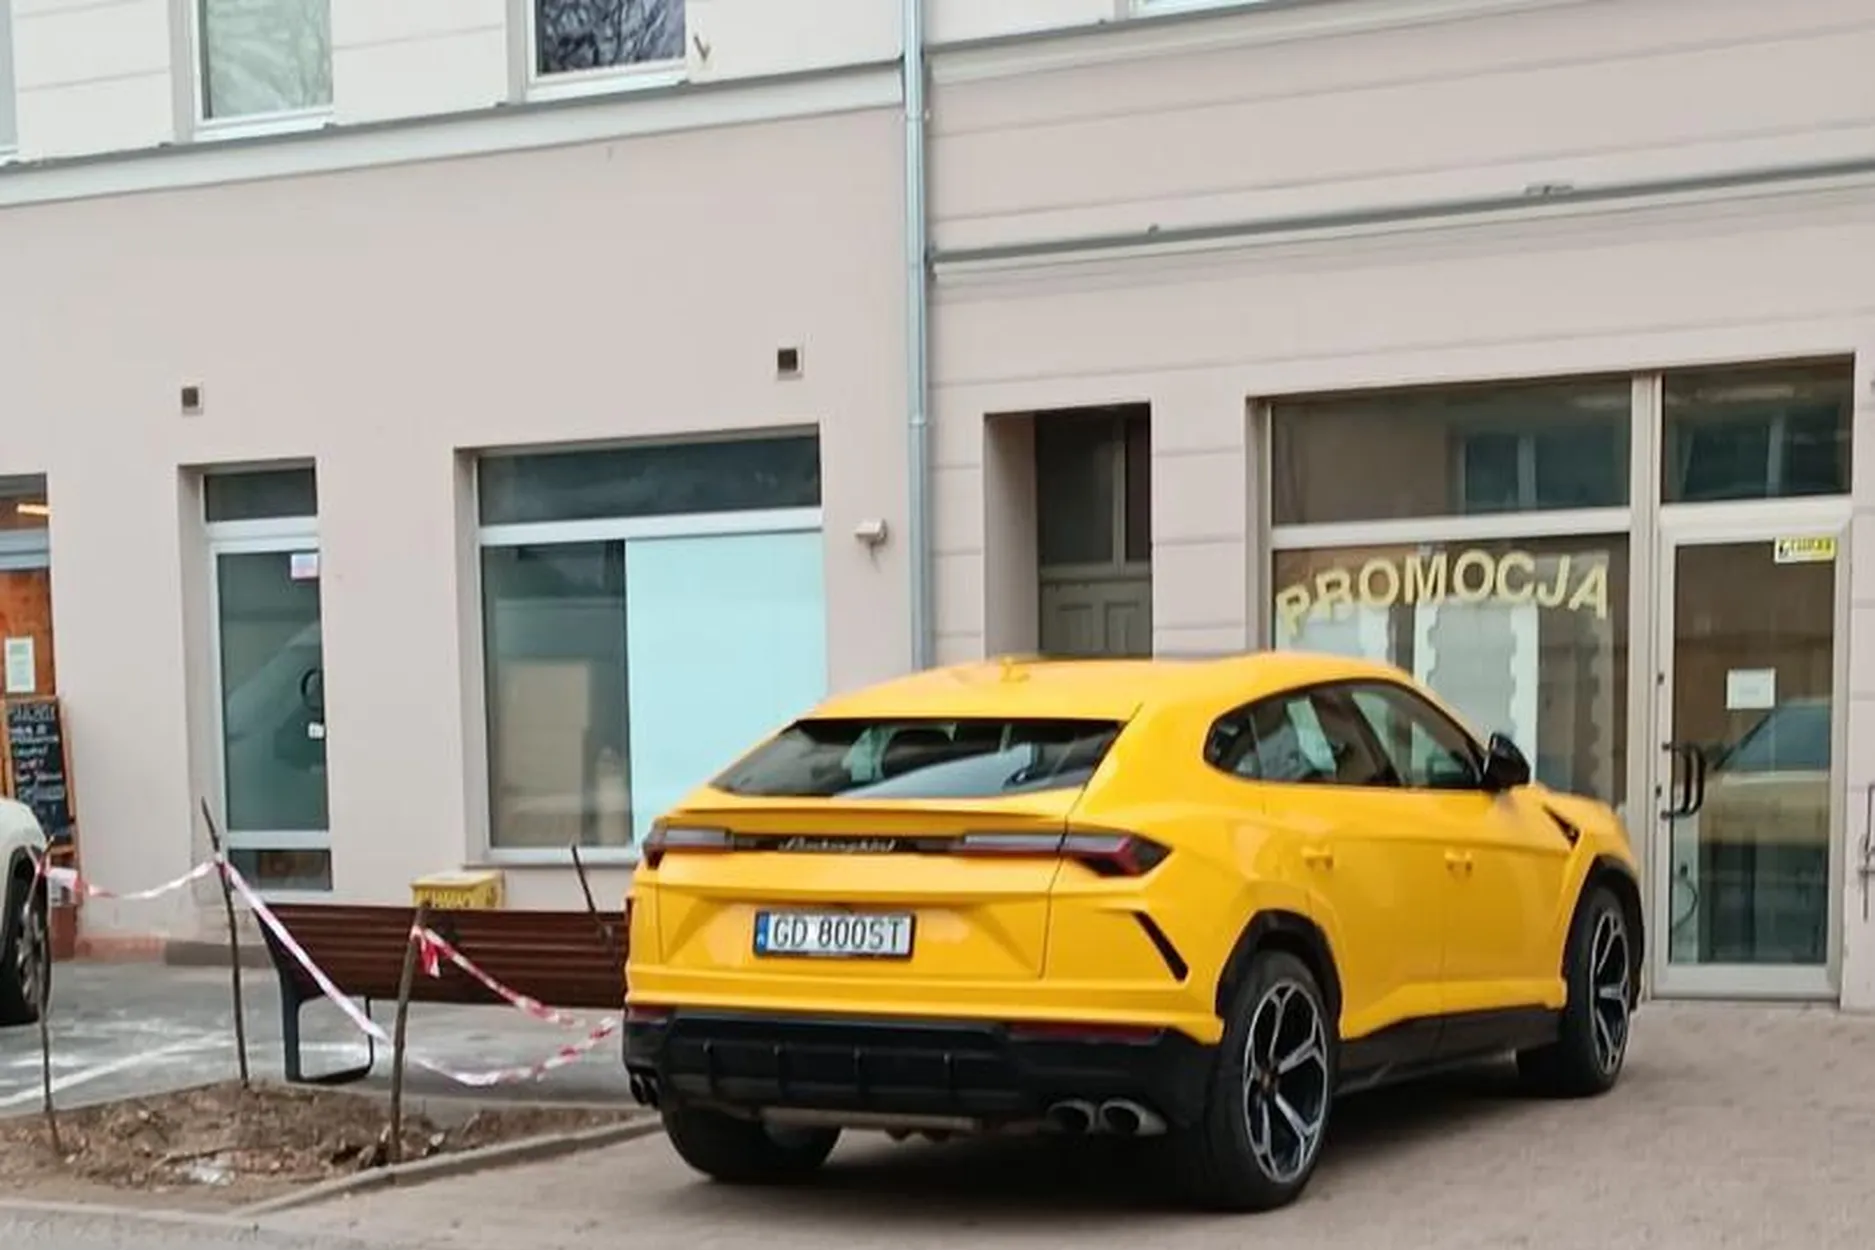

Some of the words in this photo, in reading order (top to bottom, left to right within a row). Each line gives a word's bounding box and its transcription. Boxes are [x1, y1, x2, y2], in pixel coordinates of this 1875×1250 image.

[1276, 550, 1609, 635] PROMOCJA
[774, 918, 808, 947] GD
[818, 918, 904, 951] 800ST
